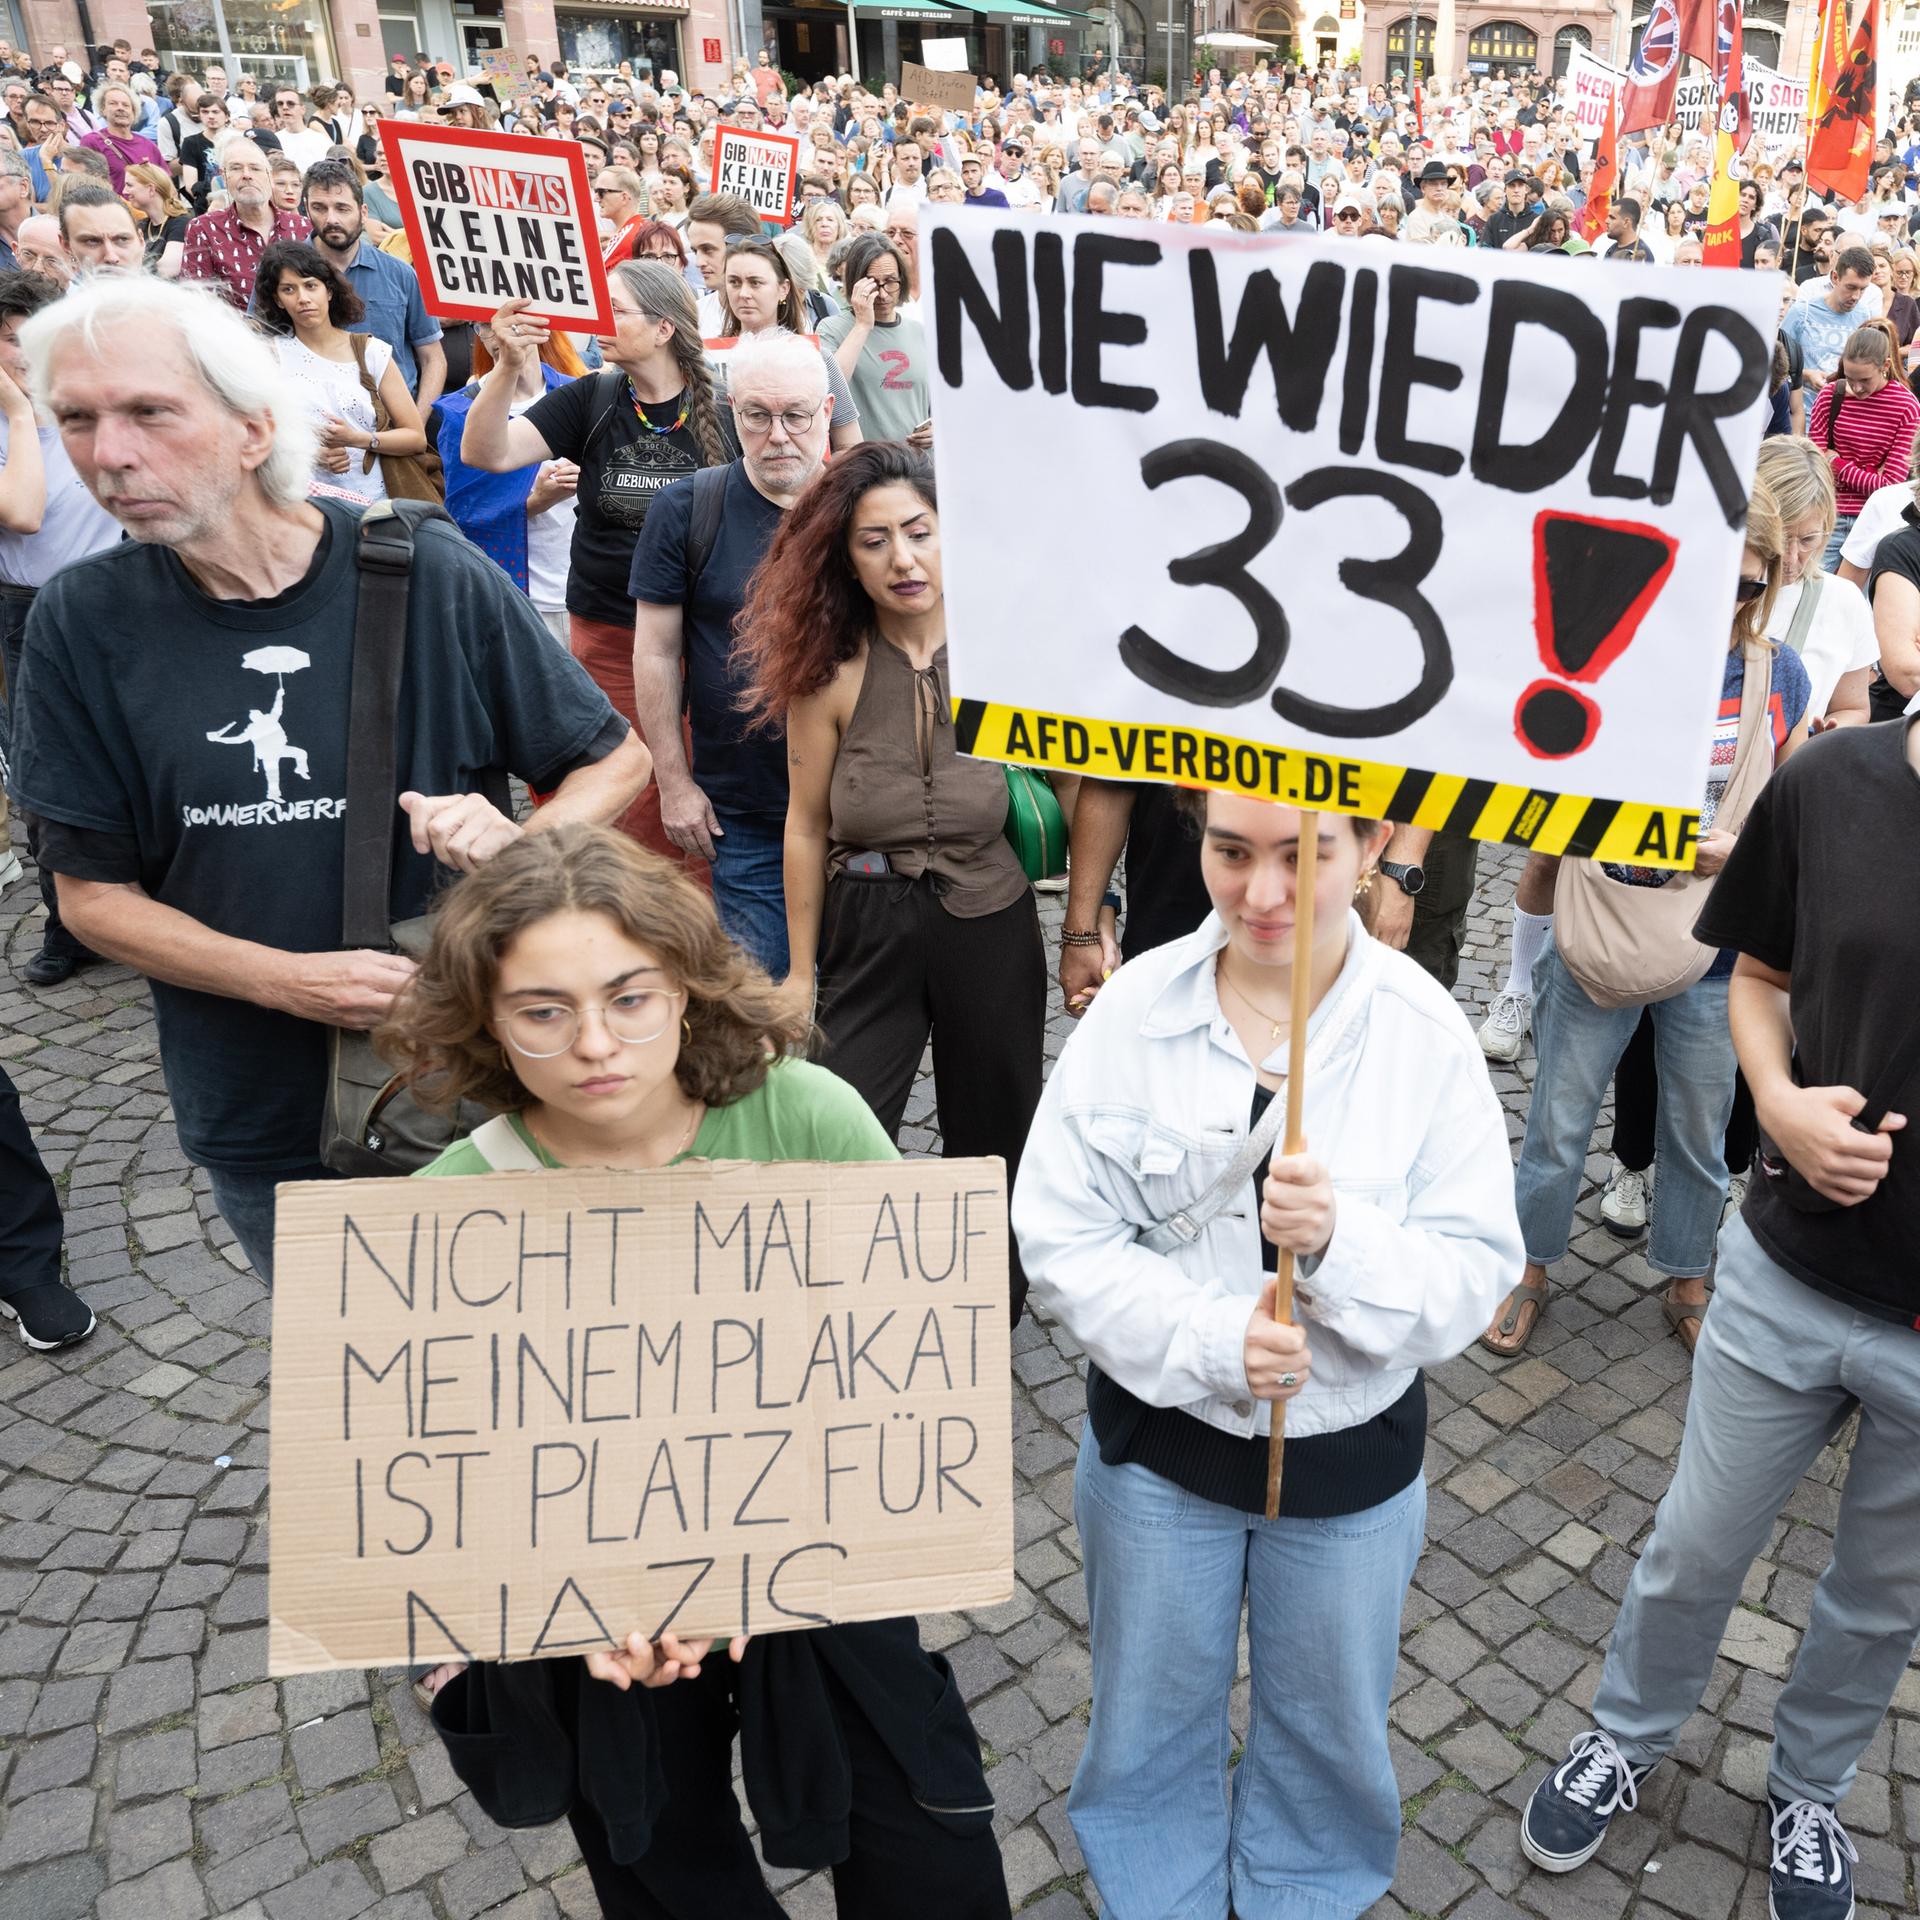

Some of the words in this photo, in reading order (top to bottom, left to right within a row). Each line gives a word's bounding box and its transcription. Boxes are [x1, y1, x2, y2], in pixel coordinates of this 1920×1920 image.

[1470, 40, 1536, 57] CHANGE
[1576, 71, 1611, 99] WER
[722, 162, 786, 192] KEINE
[724, 142, 747, 163] GIB
[748, 146, 788, 170] NAZIS
[412, 159, 471, 204] GIB
[472, 167, 569, 215] NAZIS
[424, 206, 581, 264] KEINE
[436, 253, 589, 306] CHANCE
[931, 228, 1163, 413] NIE
[1189, 249, 1770, 530] WIEDER
[620, 443, 643, 455] ROYAL
[645, 443, 676, 454] SOCIETY
[1006, 712, 1361, 808] AFD-VERBOT.DE
[341, 1208, 644, 1317] NICHT
[695, 1198, 844, 1295] MAL
[862, 1190, 998, 1284] AUF
[343, 1320, 682, 1441] MEINEM
[712, 1305, 997, 1413] PLAKAT
[356, 1452, 490, 1558] IST
[531, 1431, 793, 1549] PLATZ
[825, 1412, 982, 1525] FÜR
